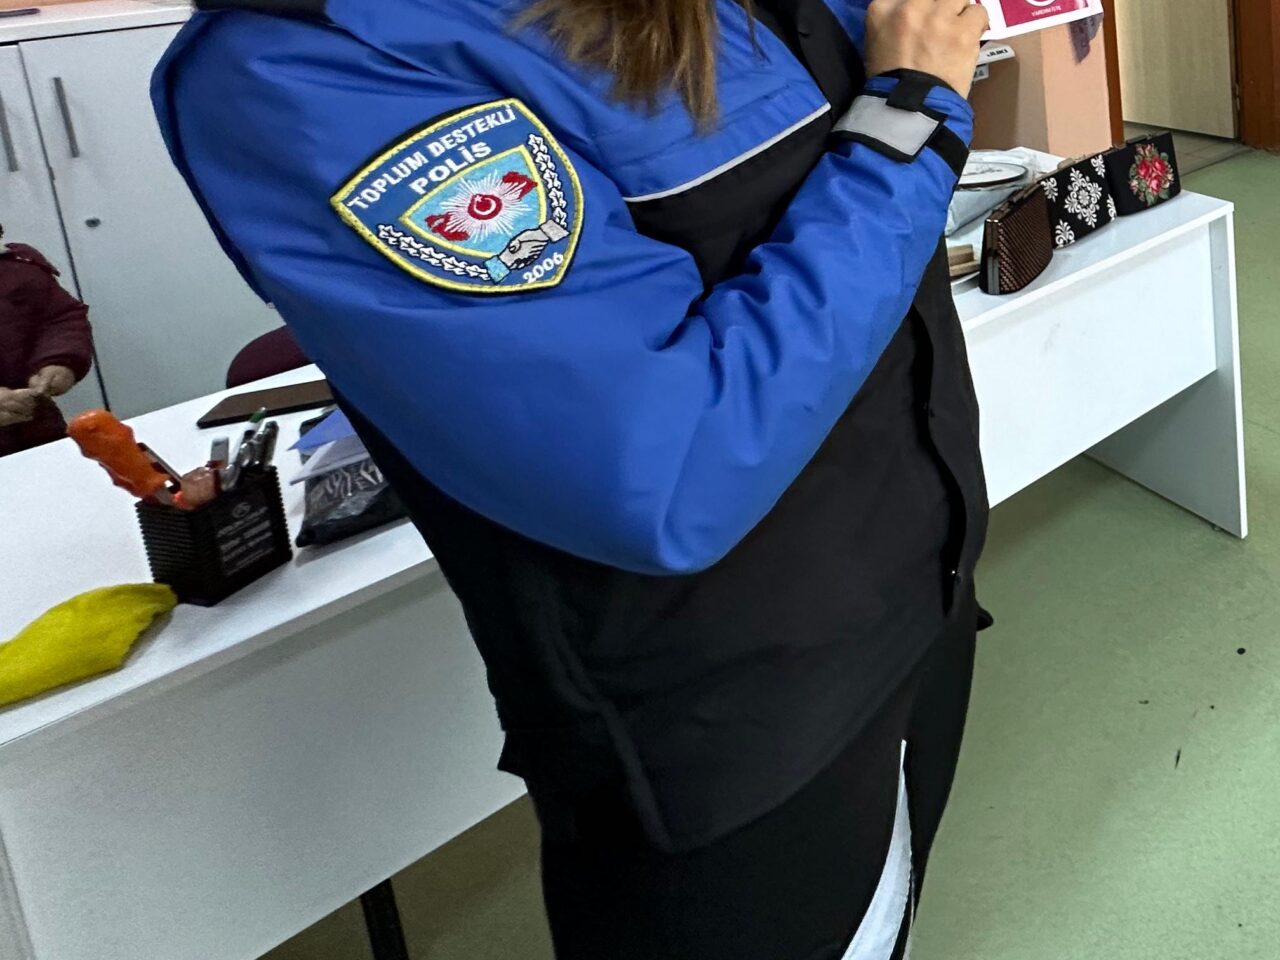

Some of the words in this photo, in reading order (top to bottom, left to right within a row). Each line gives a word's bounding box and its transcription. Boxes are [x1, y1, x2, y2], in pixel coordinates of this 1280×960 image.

[347, 151, 429, 209] TOPLUM
[426, 104, 516, 157] DESTEKLİ
[408, 141, 492, 194] POLİS
[522, 252, 564, 284] 2006
